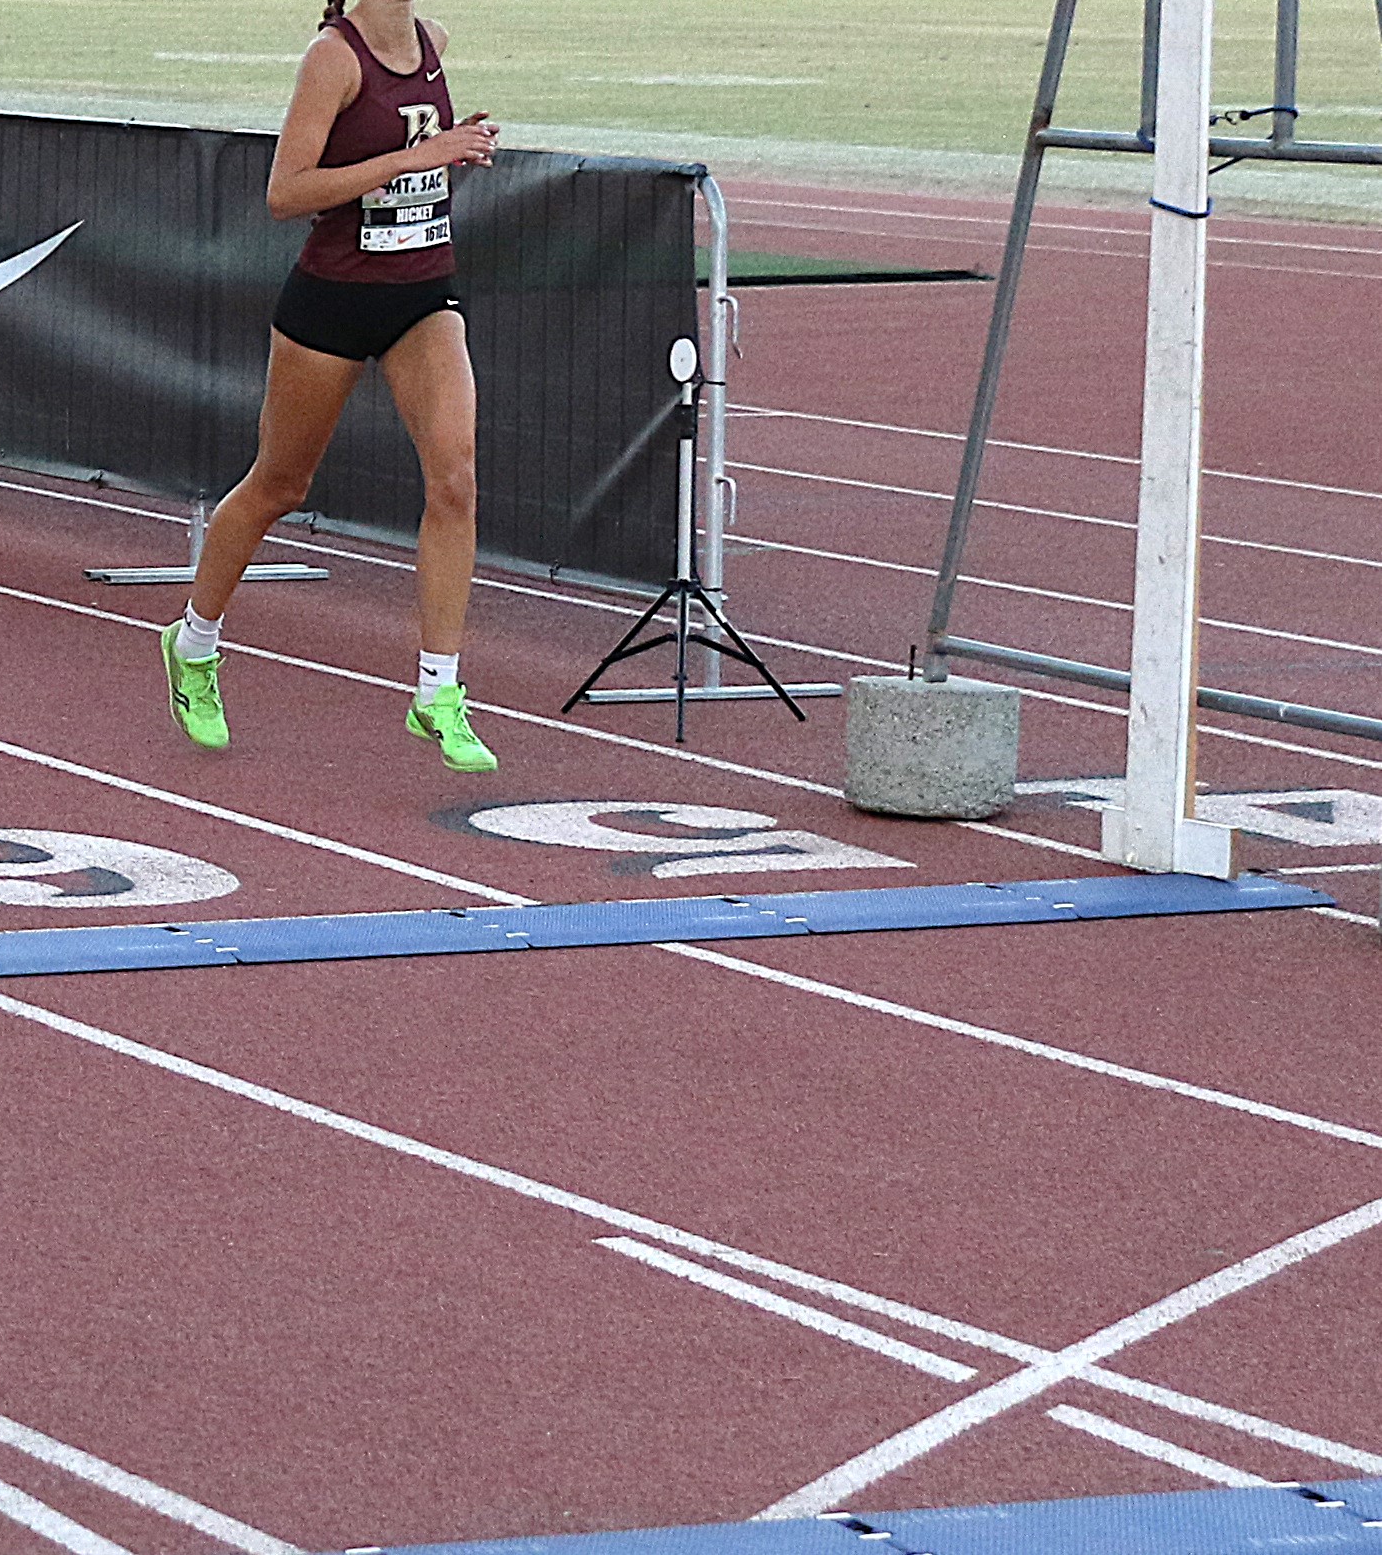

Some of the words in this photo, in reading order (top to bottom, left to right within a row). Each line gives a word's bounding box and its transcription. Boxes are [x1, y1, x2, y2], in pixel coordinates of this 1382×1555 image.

[386, 177, 416, 194] MT.
[420, 172, 443, 192] SAC
[396, 204, 434, 224] HICKEY
[468, 800, 918, 879] 5
